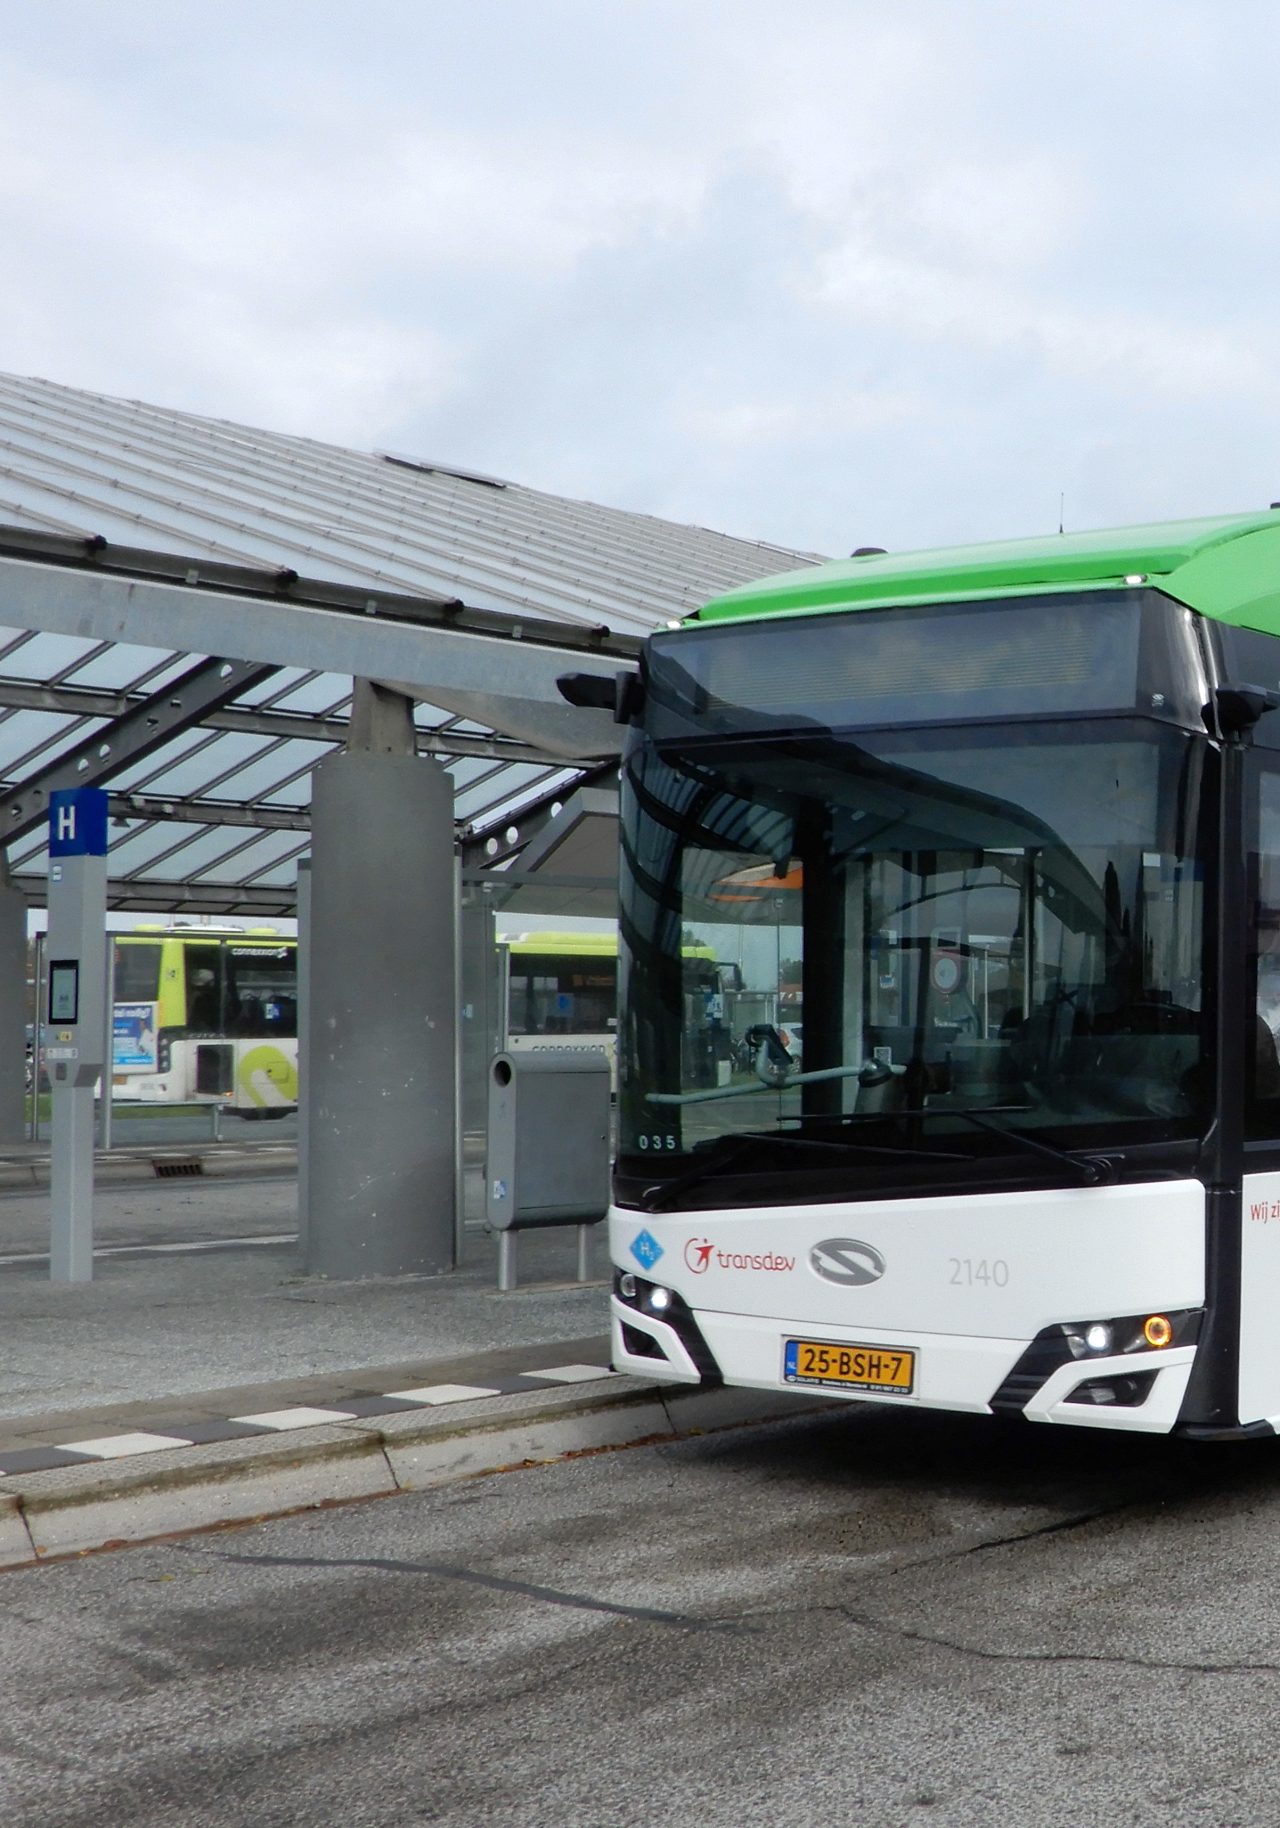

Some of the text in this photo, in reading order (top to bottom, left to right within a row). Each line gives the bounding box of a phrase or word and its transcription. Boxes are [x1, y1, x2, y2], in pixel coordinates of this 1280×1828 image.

[58, 805, 75, 840] H
[1250, 1202, 1268, 1224] Wij
[716, 1251, 796, 1272] transdev
[949, 1258, 1010, 1287] 2140
[803, 1348, 903, 1381] 25-BSH-7
